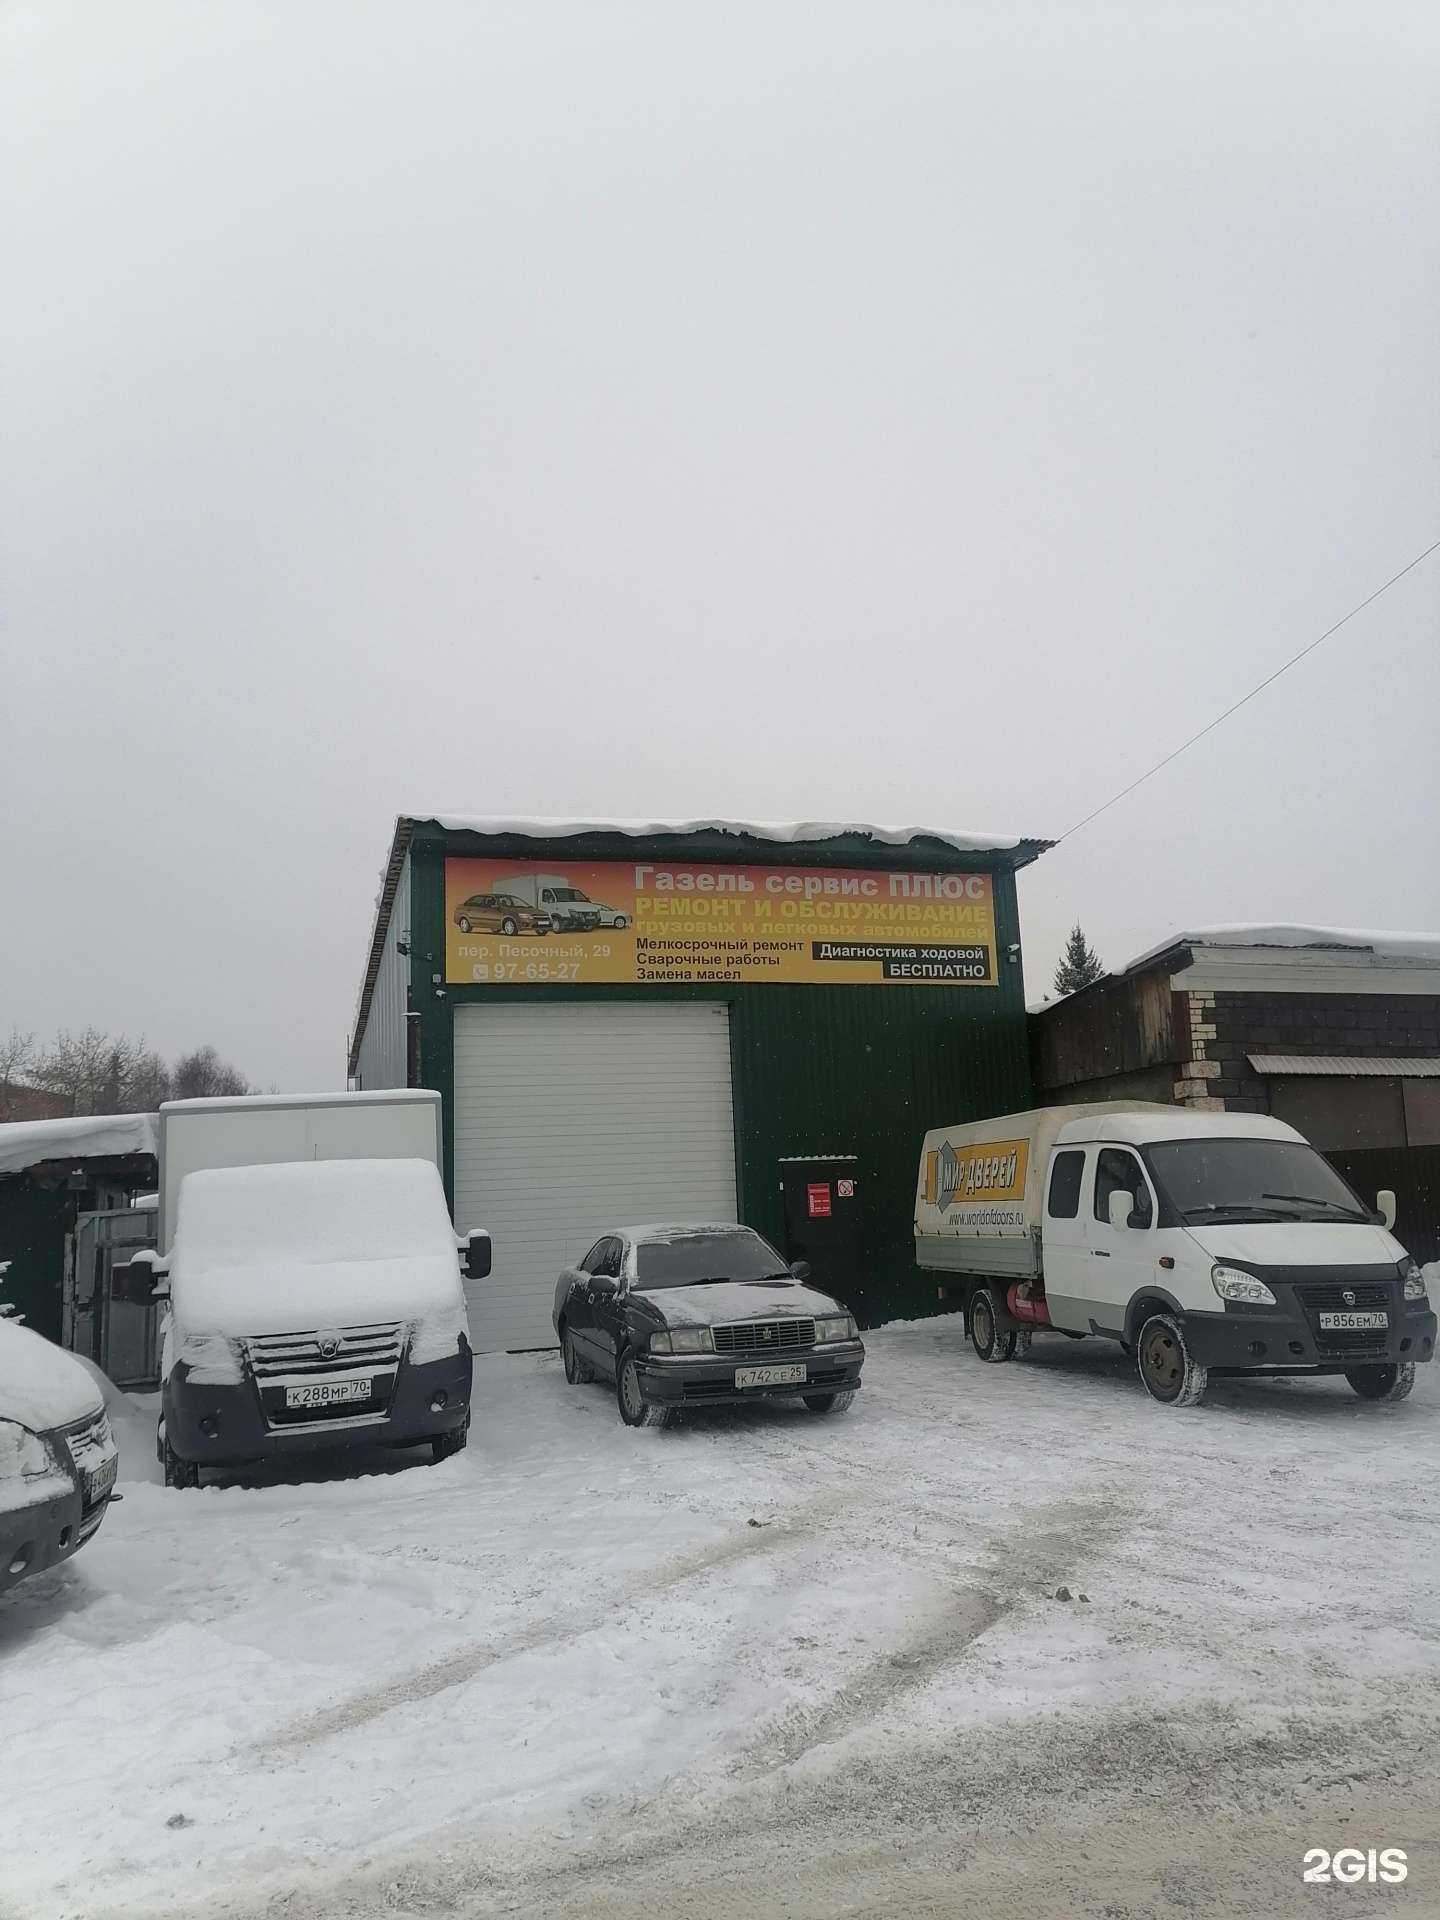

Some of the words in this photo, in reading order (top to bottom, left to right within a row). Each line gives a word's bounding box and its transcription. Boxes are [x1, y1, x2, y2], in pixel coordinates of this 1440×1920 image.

[635, 866, 755, 892] Газель
[765, 875, 878, 899] сервис
[889, 873, 984, 899] ПЛЮС
[636, 897, 746, 915] РЕМОНТ
[754, 899, 772, 917] И
[780, 900, 988, 923] ОБСЛУЖИВАНИЕ
[636, 920, 736, 935] грузовых
[743, 923, 755, 933] и
[761, 922, 857, 935] легковых
[863, 924, 989, 938] автомобилей
[458, 946, 493, 960] пер.
[499, 944, 588, 959] Песочный,
[593, 944, 611, 957] 29
[636, 938, 748, 952] Мелкосрочный
[753, 941, 804, 953] ремонт
[820, 943, 917, 959] Диагностика
[921, 946, 984, 960] ходовой
[637, 953, 722, 967] Сварочные
[726, 953, 780, 967] работы
[493, 963, 580, 979] 97-65-27
[637, 968, 692, 980] Замена
[697, 969, 741, 980] масел
[890, 964, 985, 978] БЕСПЛАТНО
[943, 1161, 966, 1192] МИР
[966, 1146, 1018, 1195] ДВЕРЕЙ
